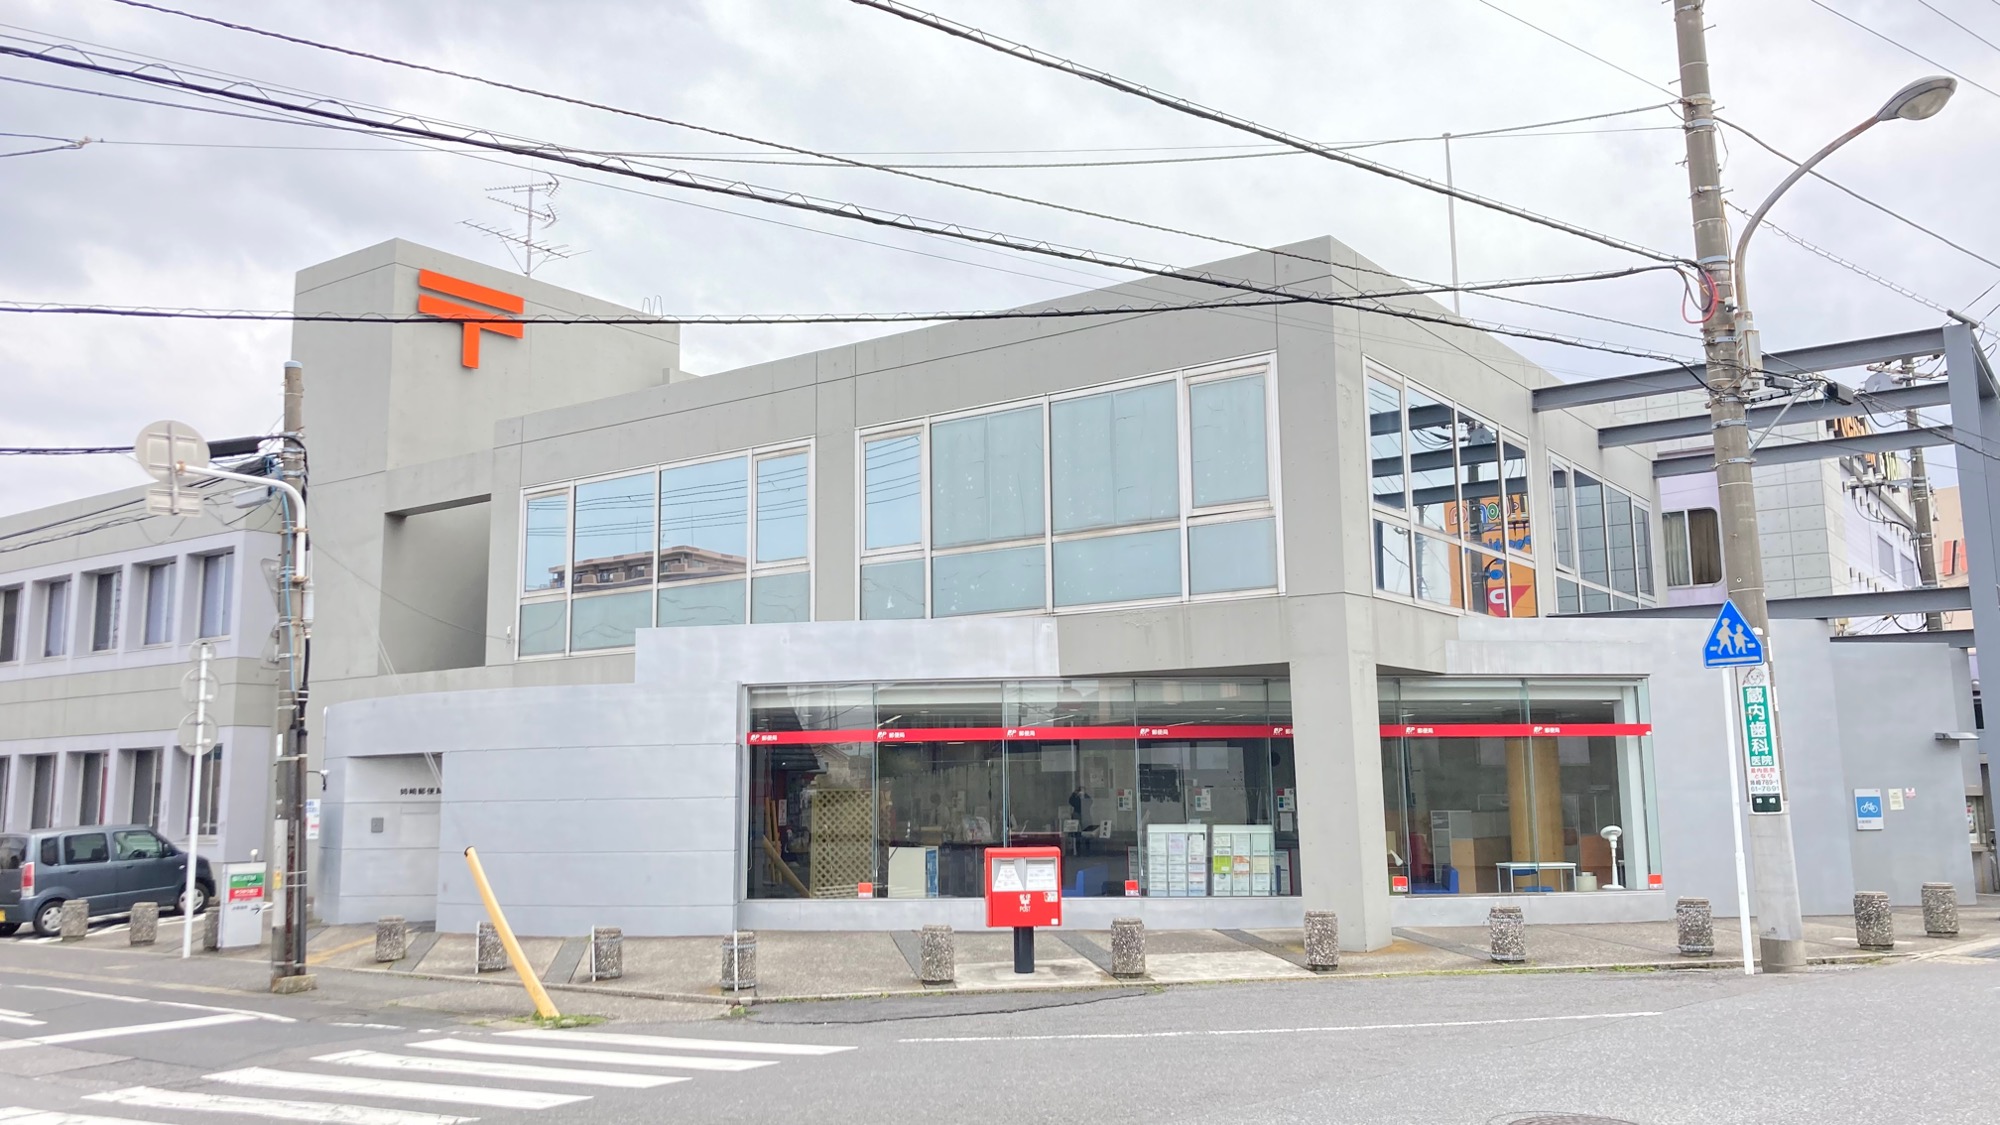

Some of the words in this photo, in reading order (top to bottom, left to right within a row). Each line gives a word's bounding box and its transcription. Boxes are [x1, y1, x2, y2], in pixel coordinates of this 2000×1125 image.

[1746, 688, 1769, 755] 蔵内歯科
[1751, 756, 1773, 765] 医院
